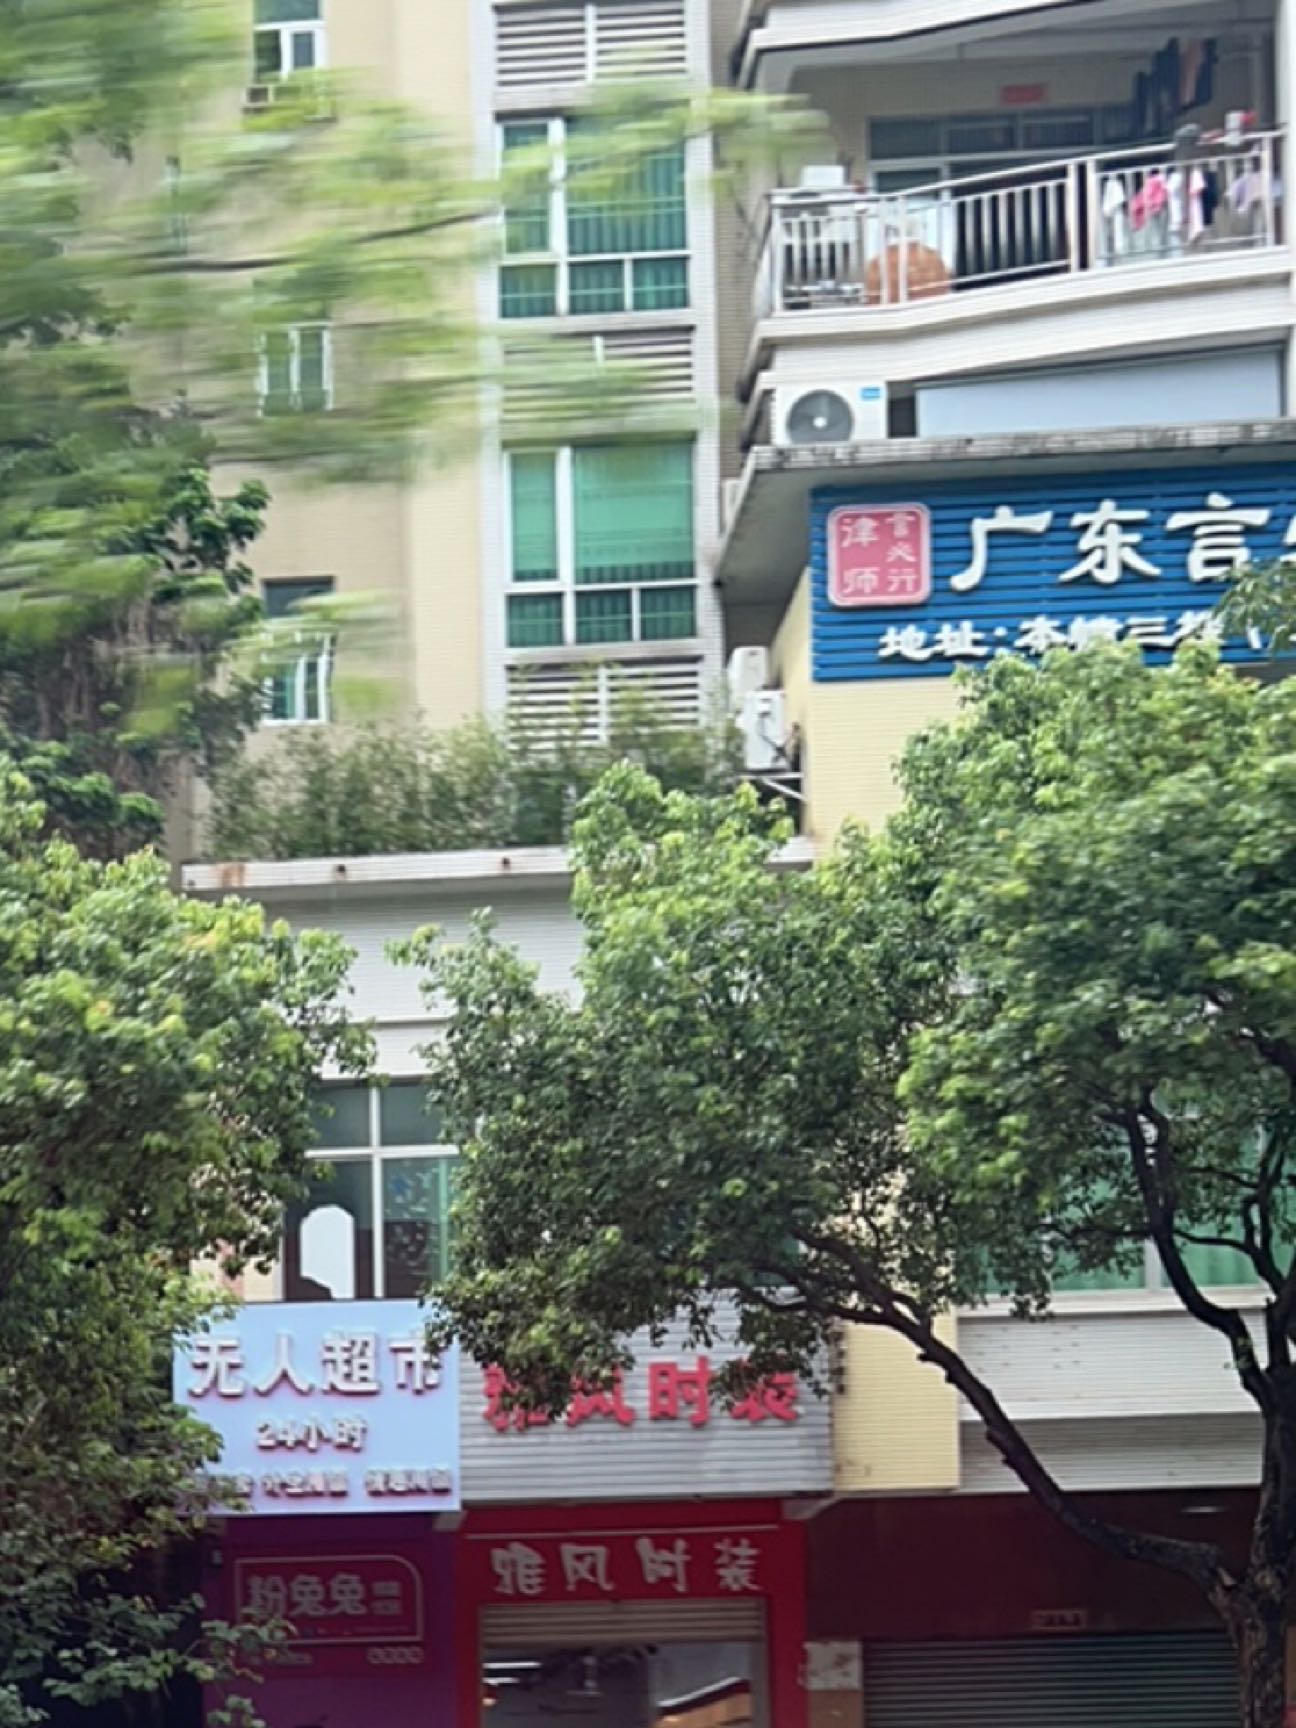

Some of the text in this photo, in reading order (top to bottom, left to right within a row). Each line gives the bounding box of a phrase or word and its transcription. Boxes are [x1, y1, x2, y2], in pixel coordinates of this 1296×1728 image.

[949, 491, 1296, 593] 广东言
[188, 1331, 447, 1397] 无人超市
[256, 1415, 368, 1454] 24小时
[489, 1537, 764, 1596] 雅风时装
